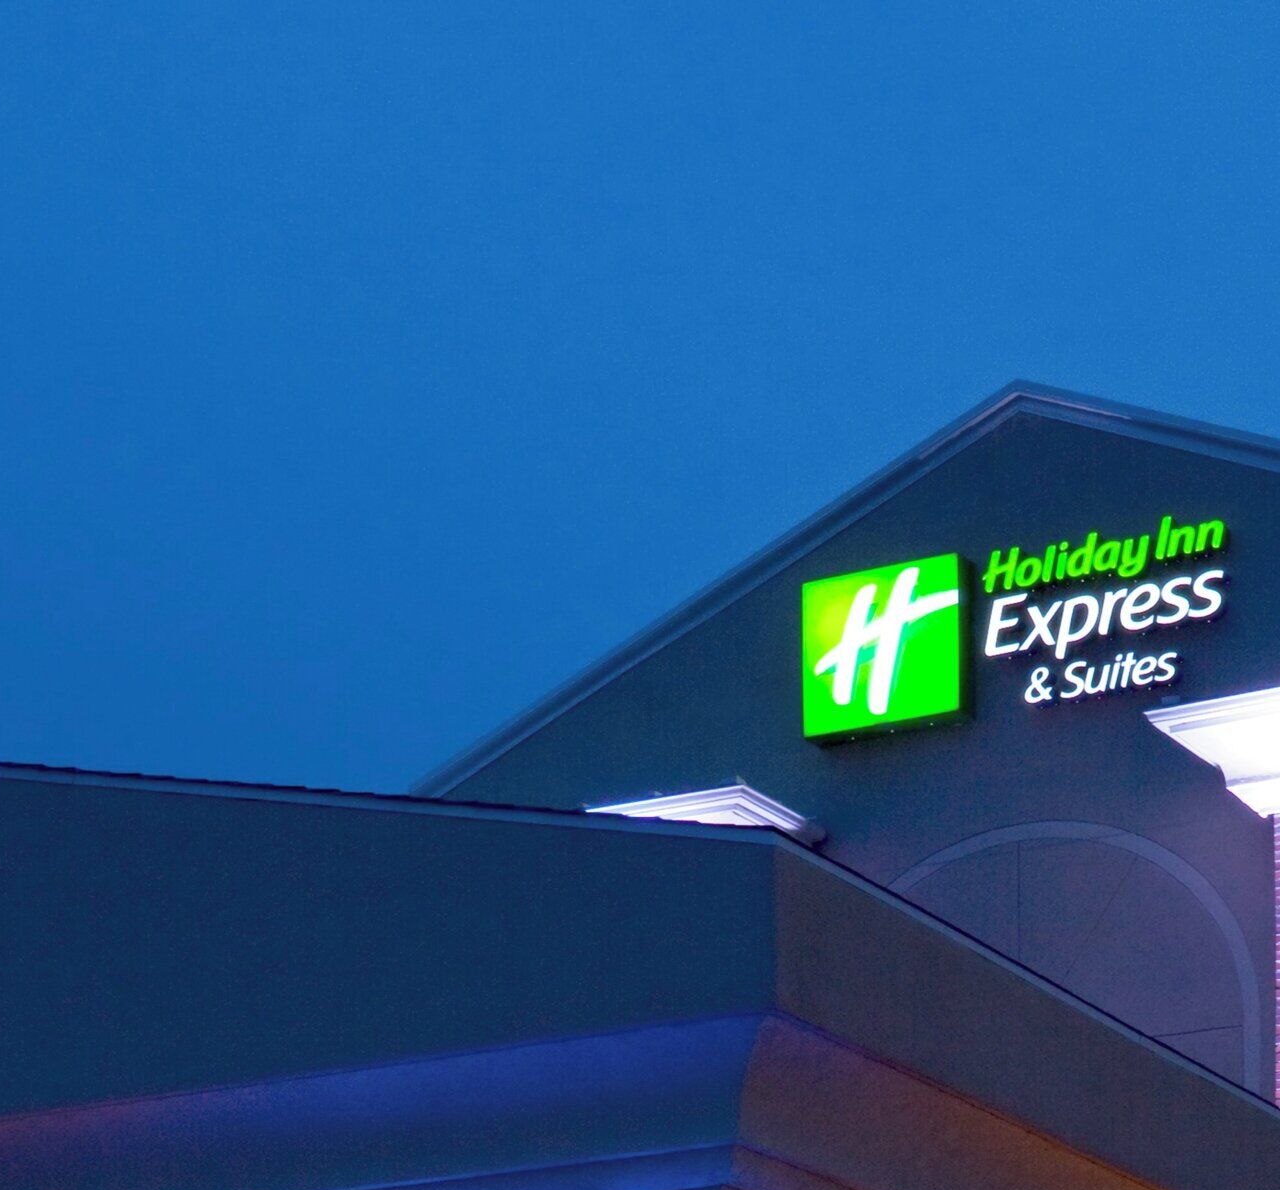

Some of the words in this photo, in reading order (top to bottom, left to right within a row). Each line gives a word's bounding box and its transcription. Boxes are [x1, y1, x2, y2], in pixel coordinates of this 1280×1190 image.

[982, 532, 1150, 592] Holiday
[1154, 516, 1224, 560] Inn
[815, 567, 959, 715] H
[984, 569, 1225, 660] Express
[1024, 666, 1053, 704] &
[1059, 651, 1178, 700] Suites
